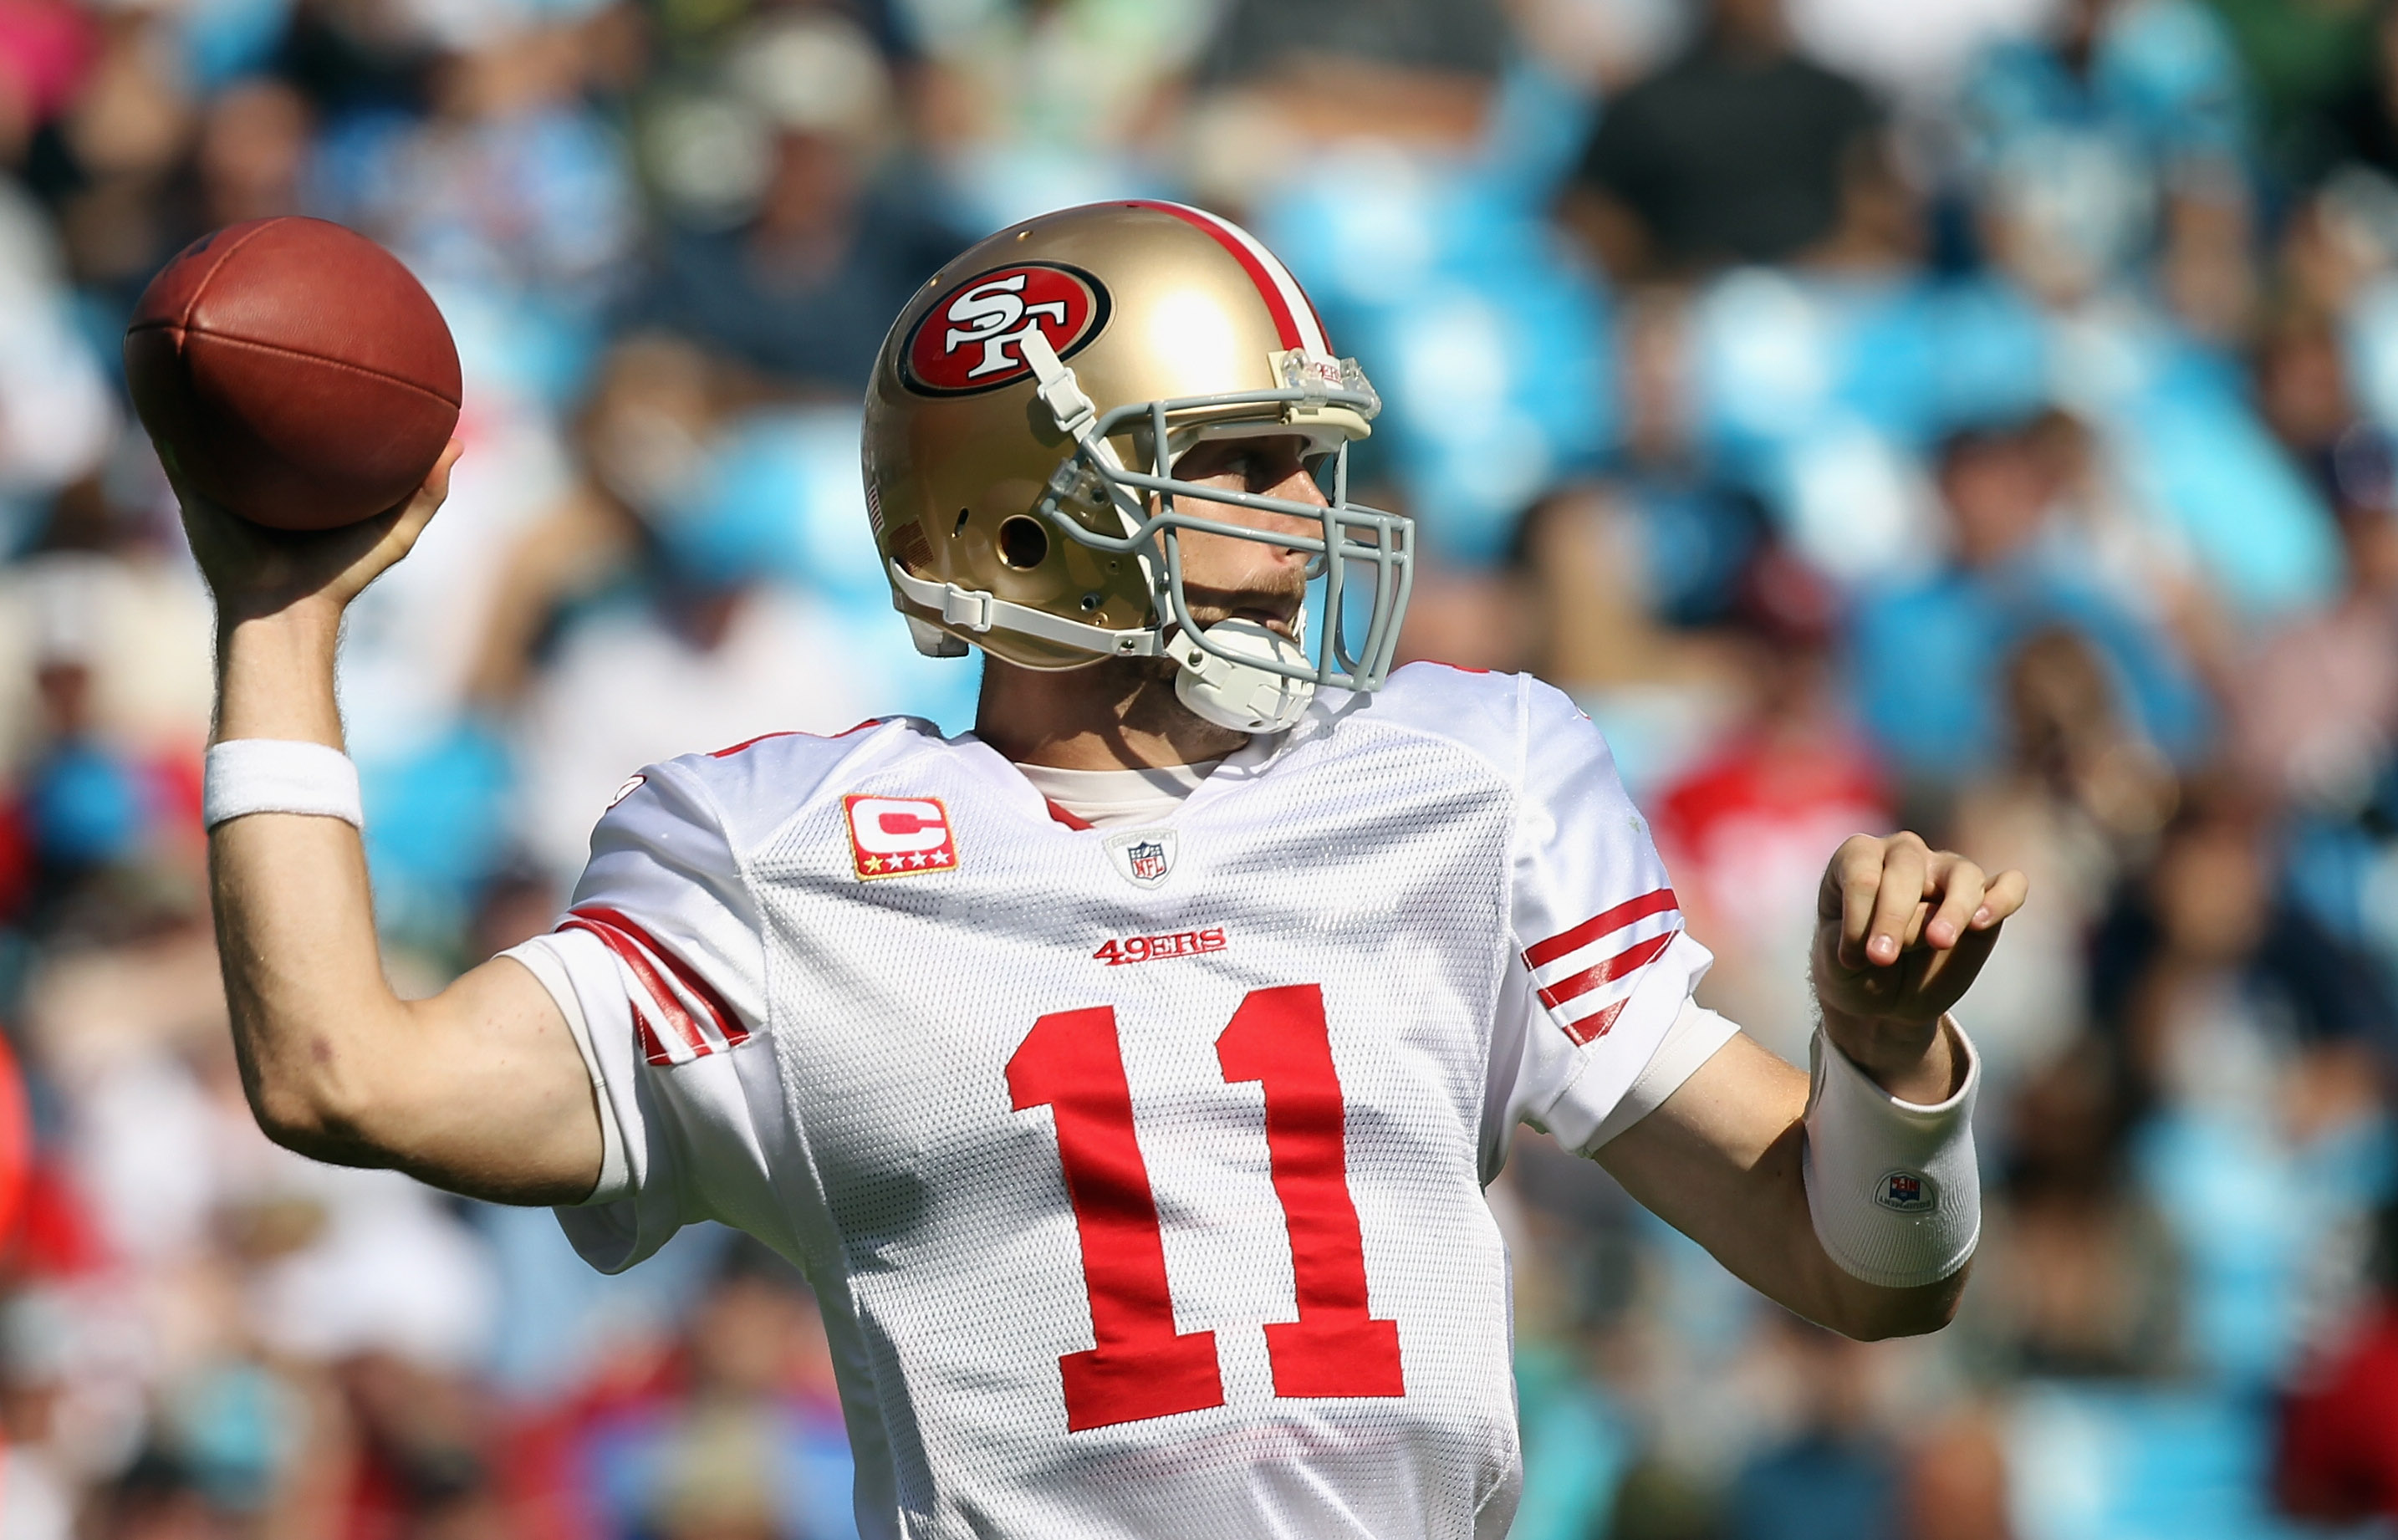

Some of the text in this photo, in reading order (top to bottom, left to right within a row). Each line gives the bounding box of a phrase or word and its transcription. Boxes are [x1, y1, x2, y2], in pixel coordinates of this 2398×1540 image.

[946, 274, 1065, 378] SF
[851, 798, 946, 854] C
[1131, 856, 1165, 877] NFL
[1093, 927, 1227, 966] 49ERS
[1005, 983, 1405, 1433] 11
[1891, 1177, 1919, 1192] NFL
